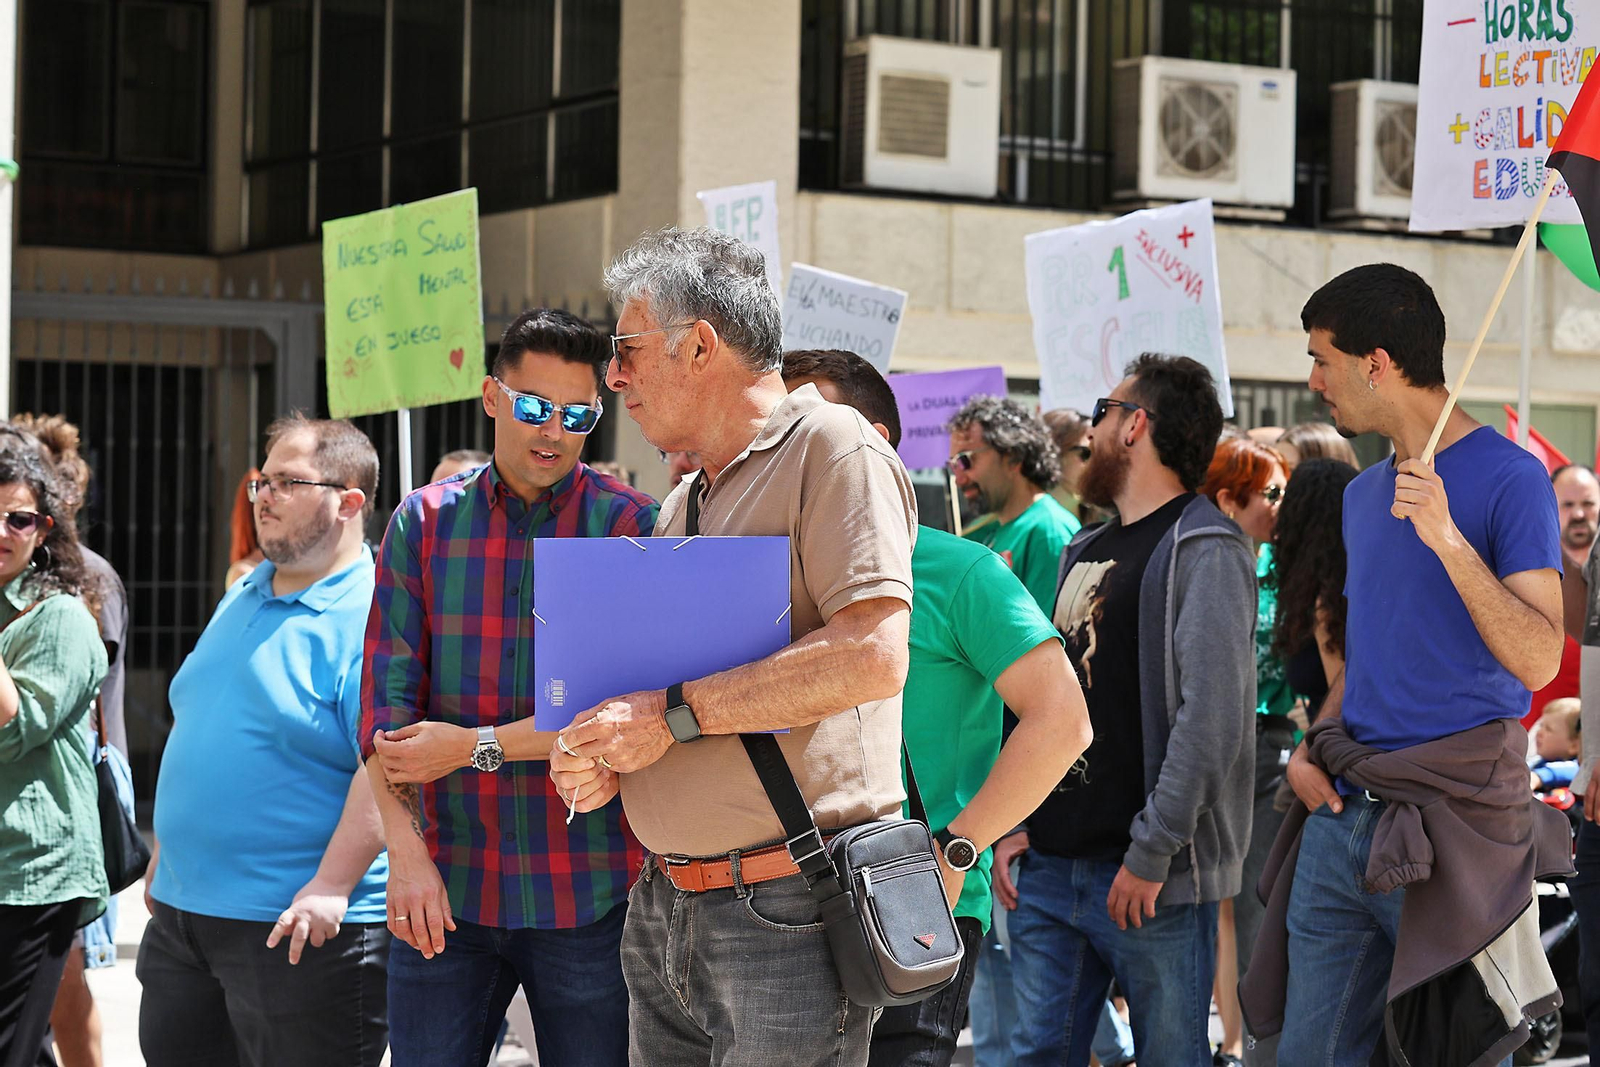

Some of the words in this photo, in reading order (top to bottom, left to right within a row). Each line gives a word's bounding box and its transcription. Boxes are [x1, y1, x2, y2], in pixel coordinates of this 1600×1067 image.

[1484, 0, 1573, 44] HORAS
[337, 239, 408, 270] NUESTRA
[1107, 245, 1131, 301] 1
[418, 267, 467, 295] MENTAL
[355, 334, 377, 357] EN
[386, 325, 442, 351] JUEGO
[784, 314, 884, 358] LUCHANDO
